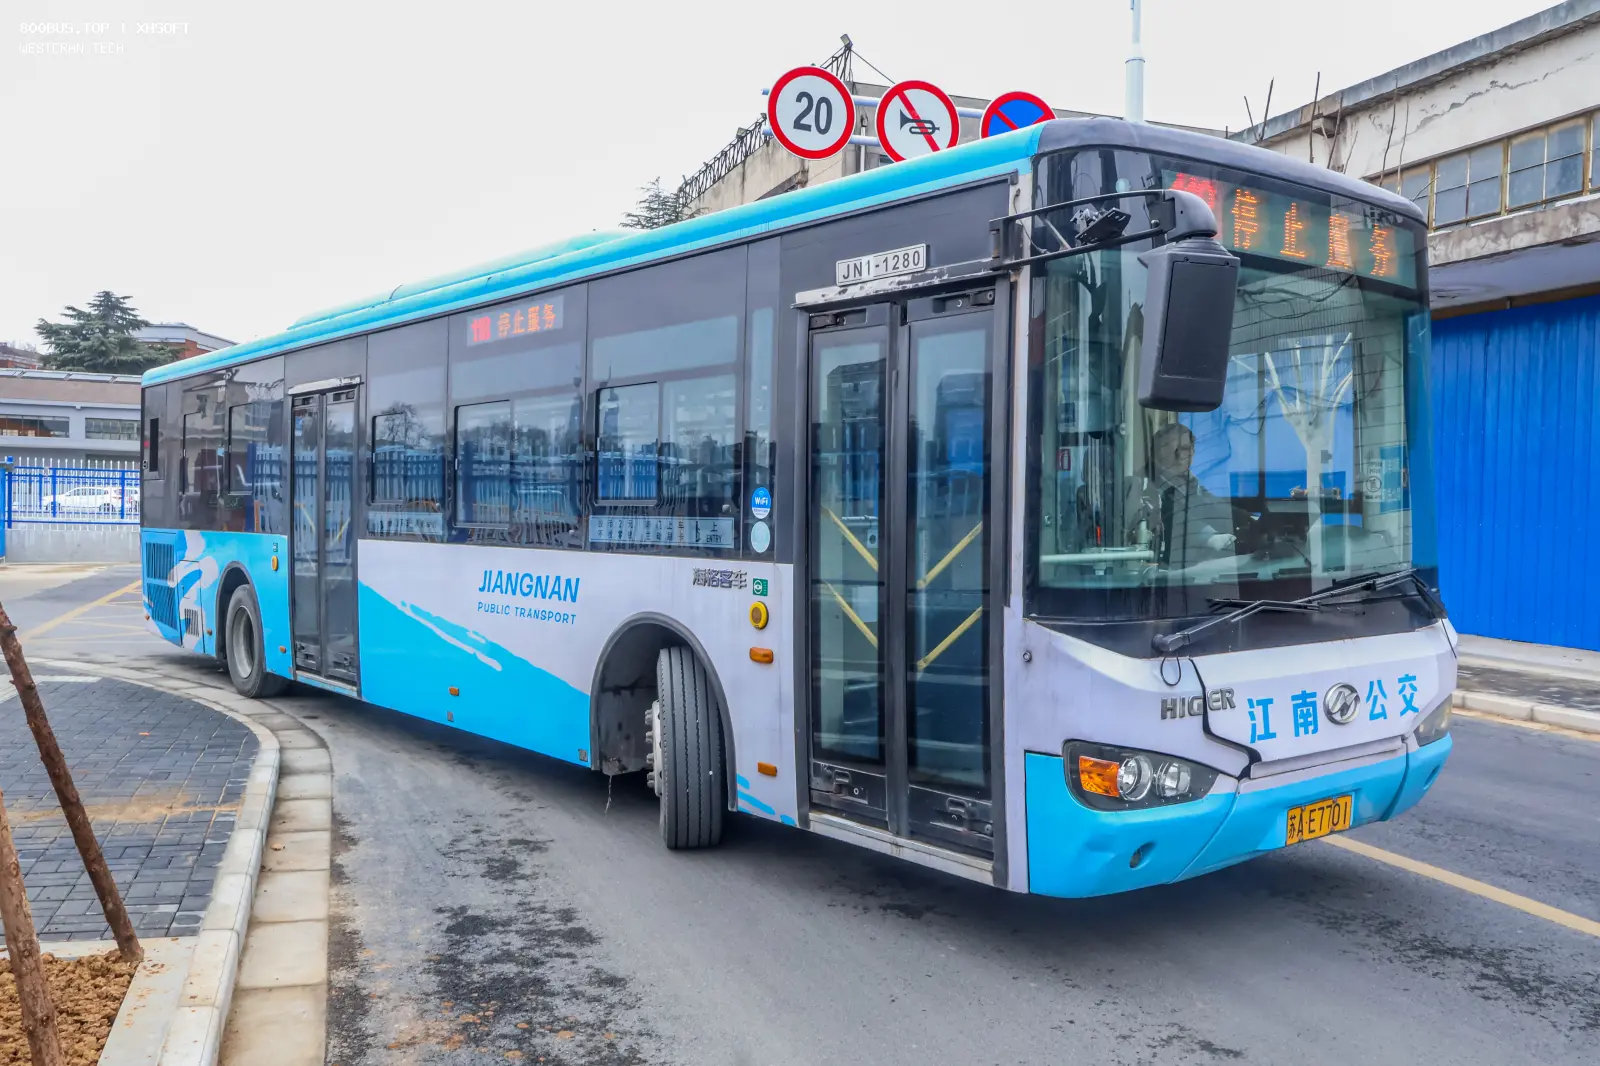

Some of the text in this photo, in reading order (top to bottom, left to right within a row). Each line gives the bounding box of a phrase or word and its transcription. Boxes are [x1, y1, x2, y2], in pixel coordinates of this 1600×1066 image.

[793, 91, 833, 135] 20
[842, 250, 921, 280] JN1-1280
[754, 496, 768, 506] WiFi
[478, 569, 580, 603] JIANGNAN
[477, 601, 577, 625] PUBLIC TRANSPORT
[1160, 686, 1236, 721] HIGER
